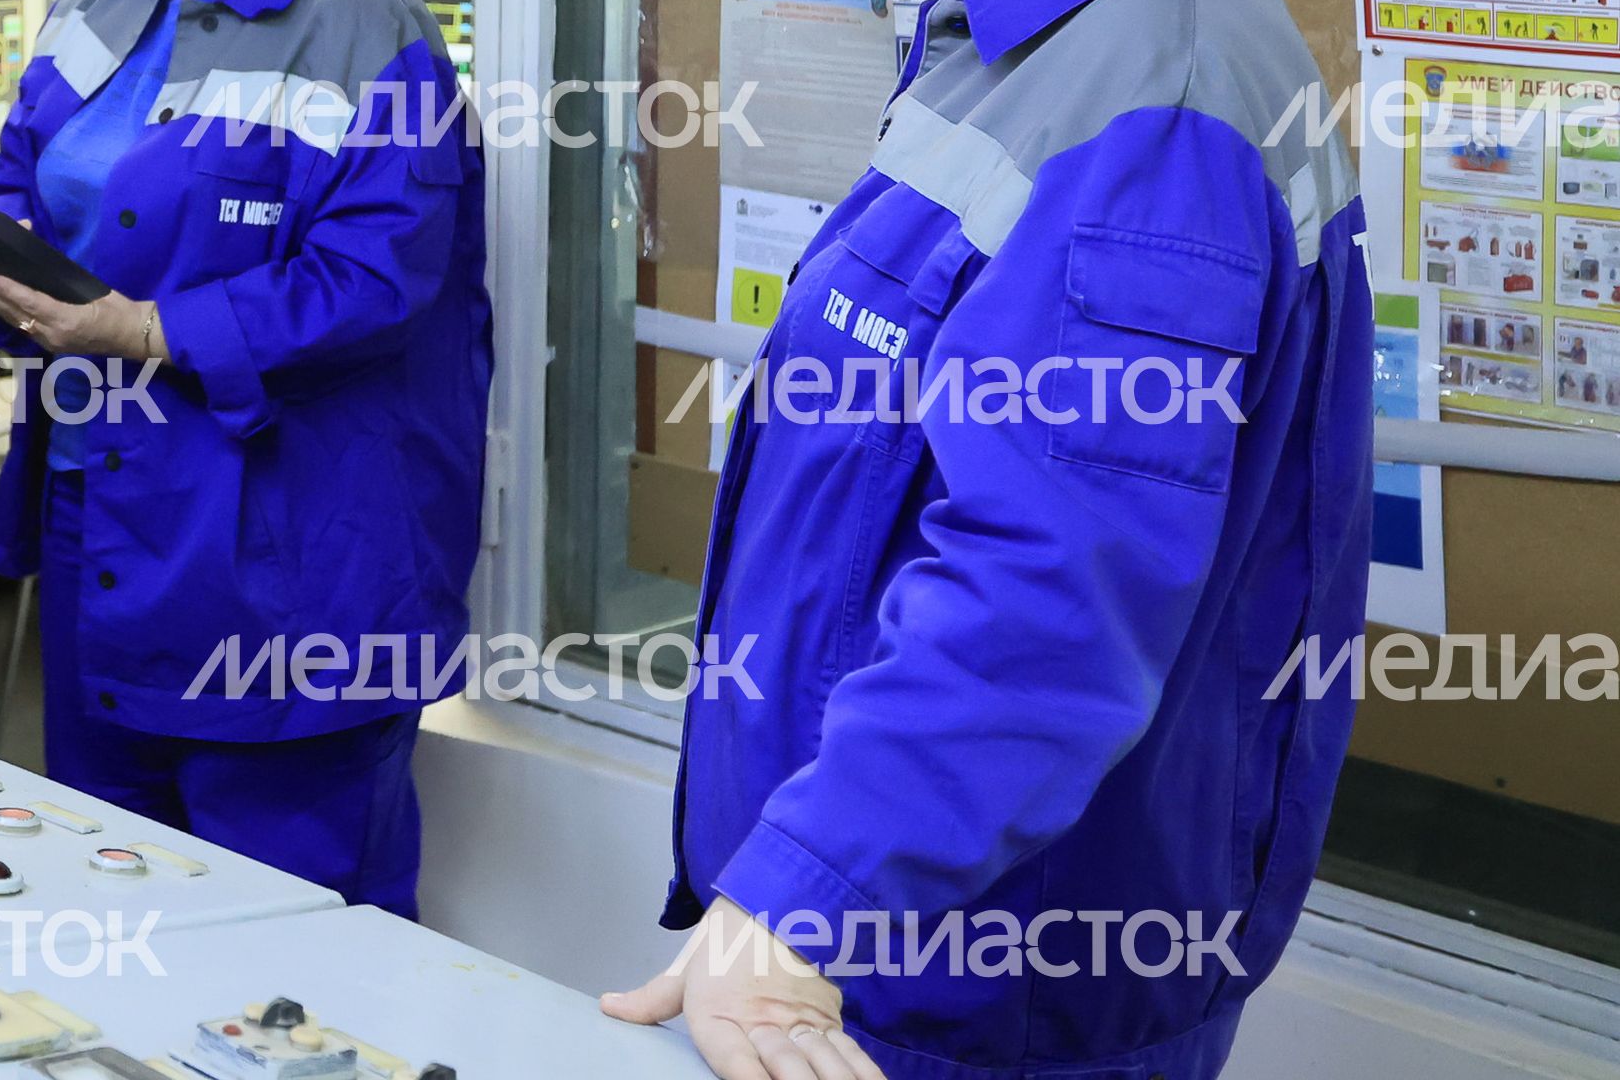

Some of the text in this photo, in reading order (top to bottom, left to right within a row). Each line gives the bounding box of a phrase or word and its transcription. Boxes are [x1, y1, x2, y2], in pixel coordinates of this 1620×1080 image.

[1457, 74, 1620, 102] УМЕЙ ДЕЙСТВО
[219, 198, 240, 223] ТСК
[822, 287, 909, 360] ТСК МОСЭ
